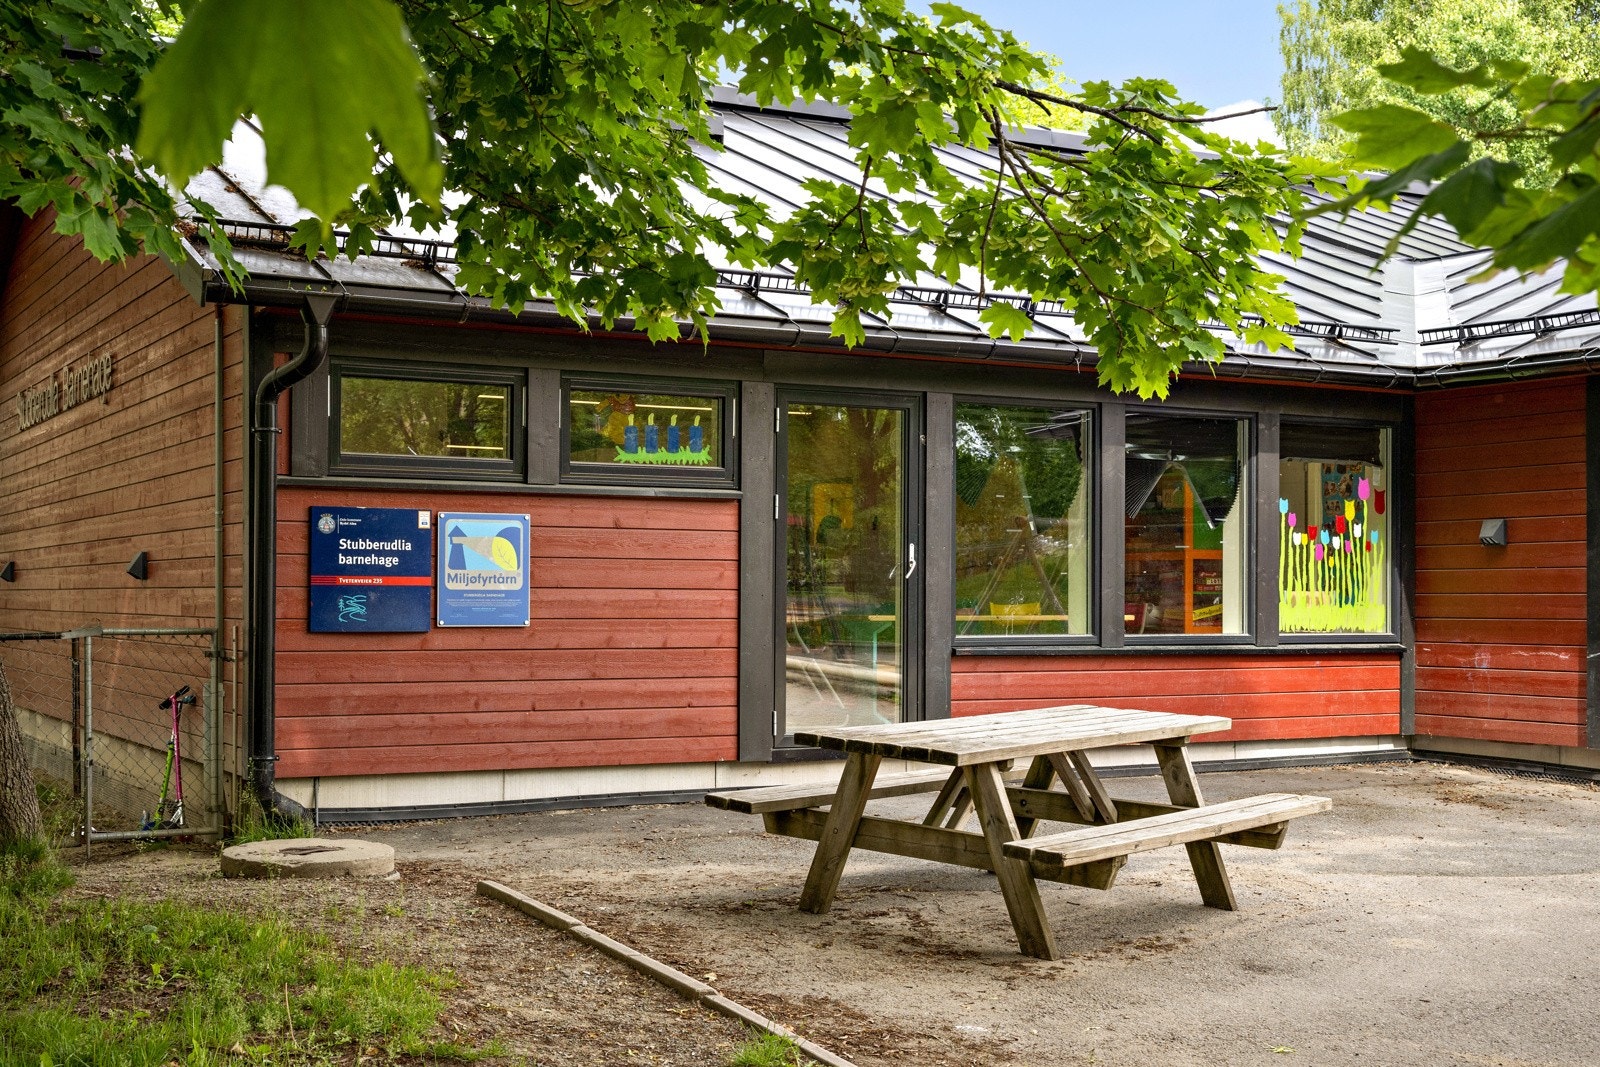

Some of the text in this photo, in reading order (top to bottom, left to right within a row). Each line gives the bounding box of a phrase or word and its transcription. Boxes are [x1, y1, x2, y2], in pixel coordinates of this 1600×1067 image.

[339, 538, 412, 551] Stubberudlia
[338, 553, 399, 568] barnehage
[447, 572, 517, 587] Miljøfyrtårn
